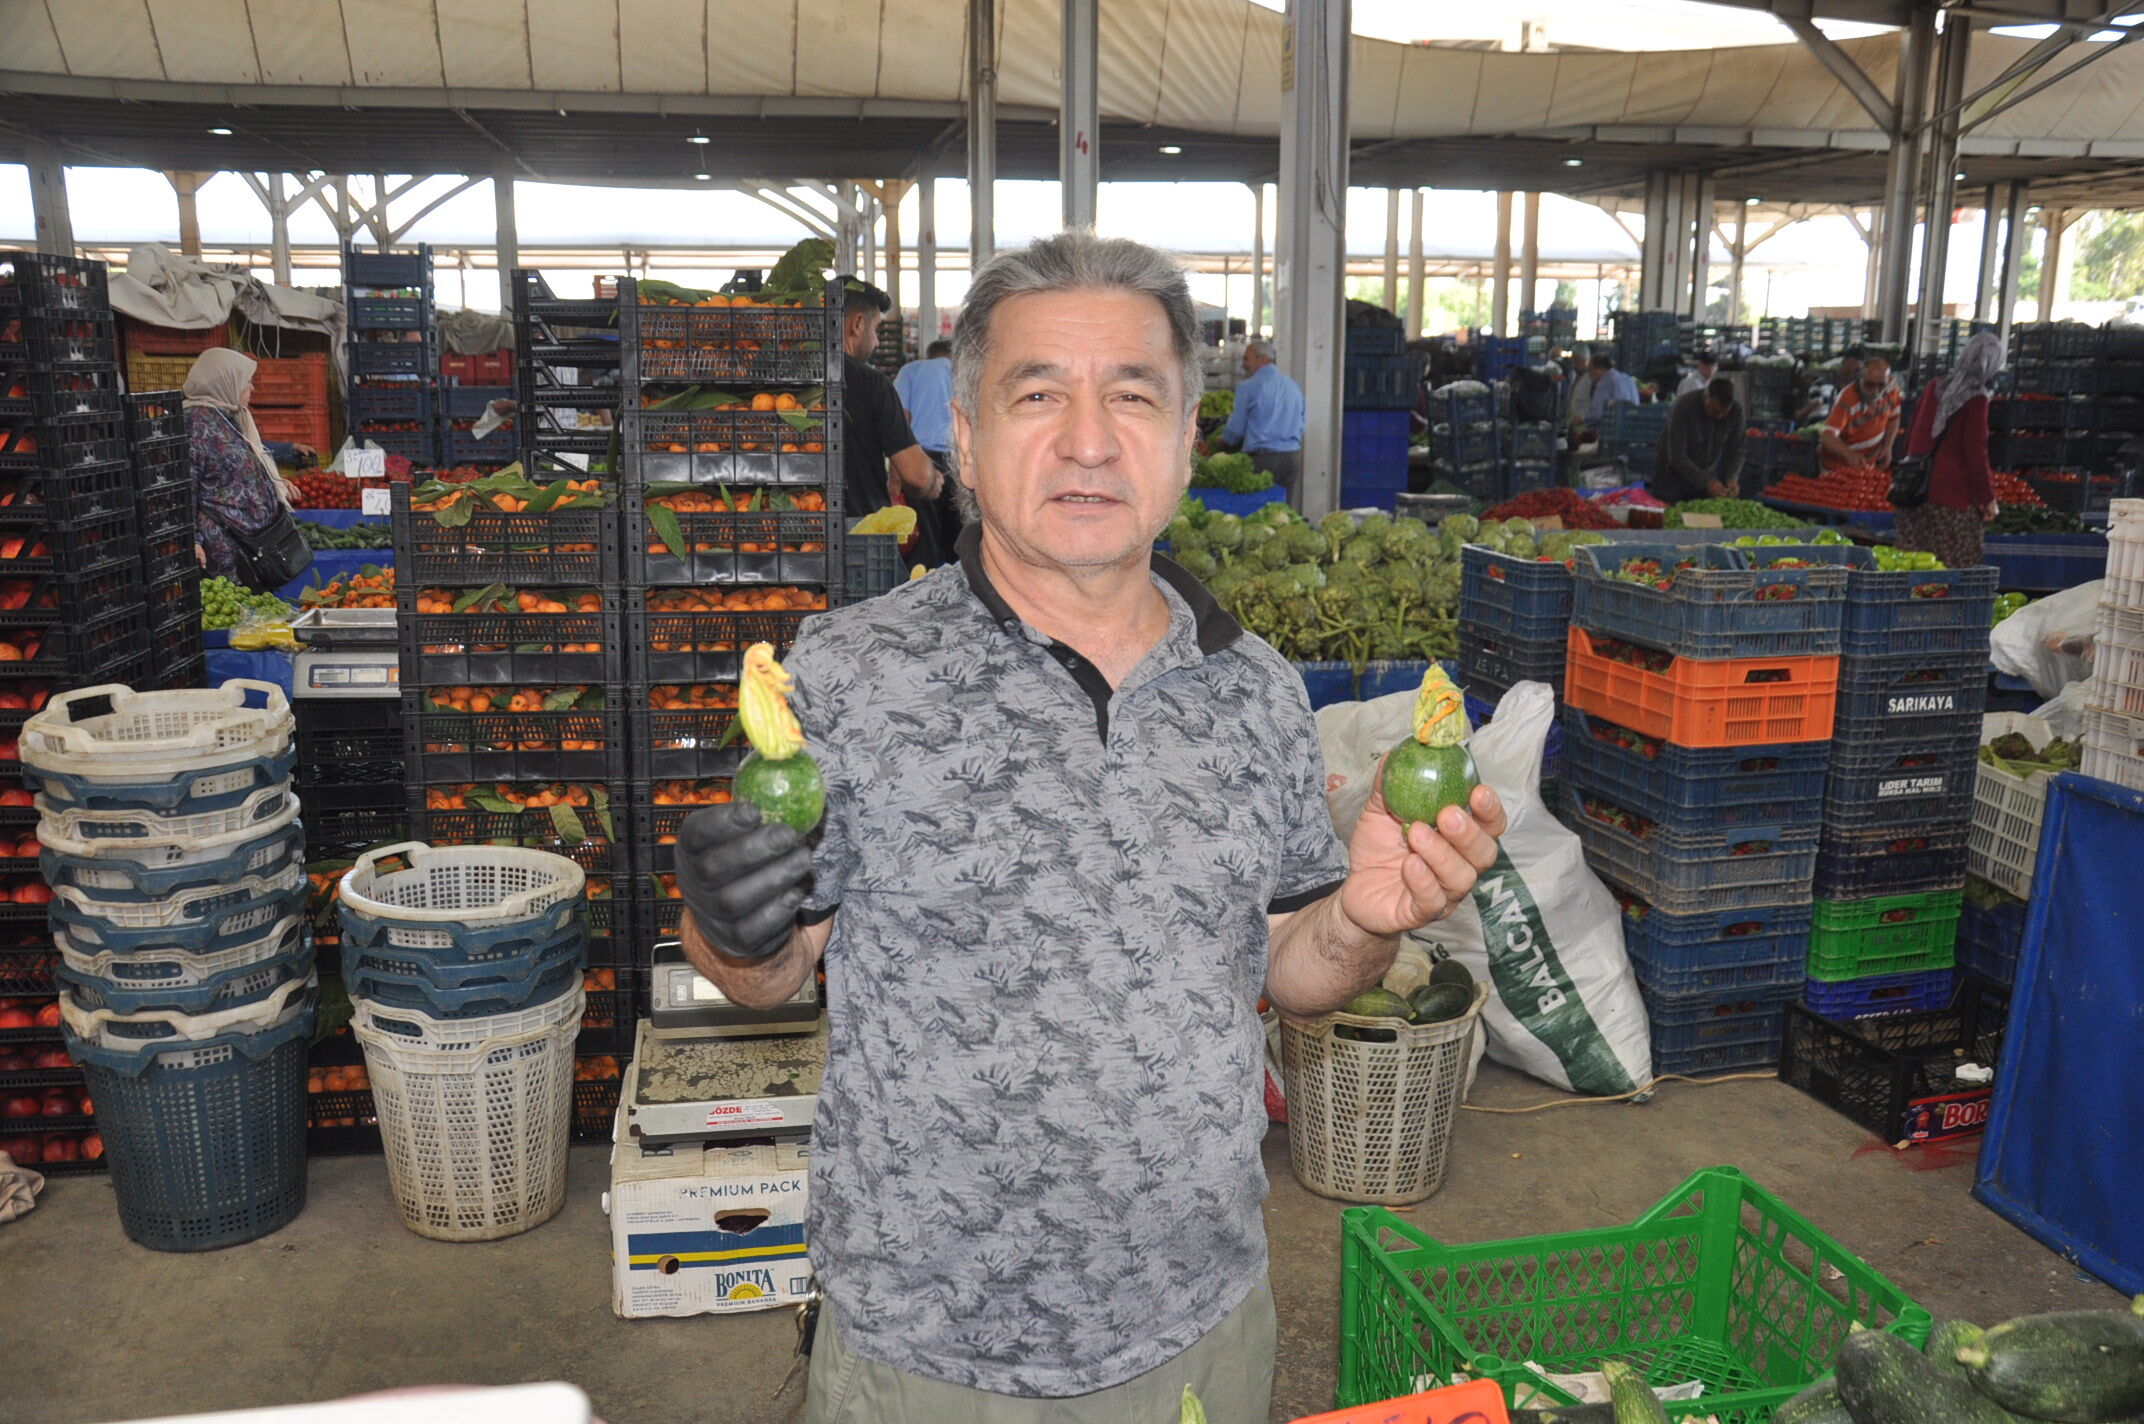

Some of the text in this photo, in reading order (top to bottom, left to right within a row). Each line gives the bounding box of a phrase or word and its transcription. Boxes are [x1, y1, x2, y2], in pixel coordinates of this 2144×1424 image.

[1888, 696, 1953, 713] SARIKAYA
[1910, 777, 1943, 788] TARIM
[1479, 875, 1568, 1015] BALCAN
[760, 1179, 801, 1195] PACK
[715, 1268, 776, 1297] BONITA
